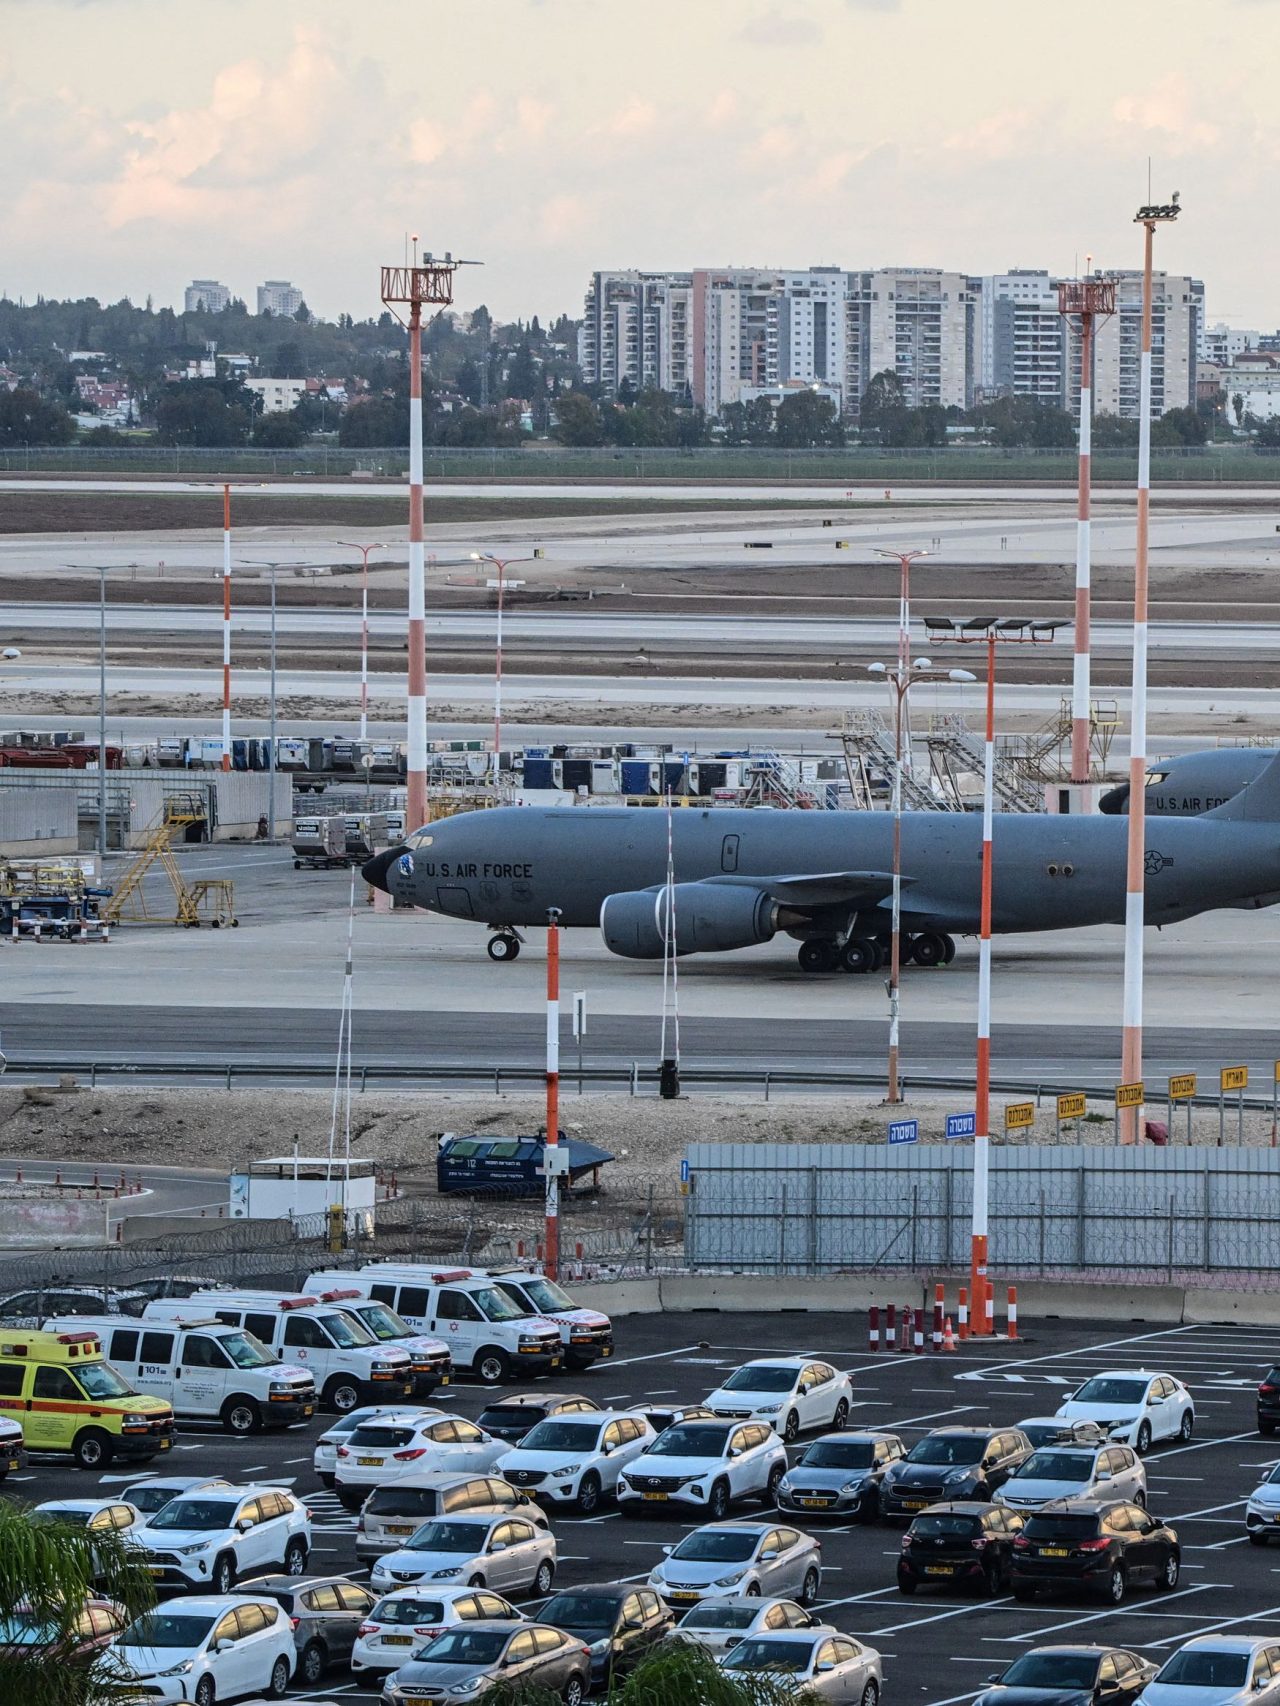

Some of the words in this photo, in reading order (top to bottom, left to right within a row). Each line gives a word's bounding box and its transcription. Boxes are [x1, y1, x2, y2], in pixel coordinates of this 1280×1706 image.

[1156, 797, 1180, 810] U.S.
[1182, 798, 1201, 810] AIR
[426, 863, 454, 877] U.S.
[456, 863, 477, 878] AIR
[483, 863, 533, 878] FORCE
[891, 1124, 915, 1141] משטרה
[949, 1117, 973, 1133] משטרה
[144, 1365, 160, 1374] 101
